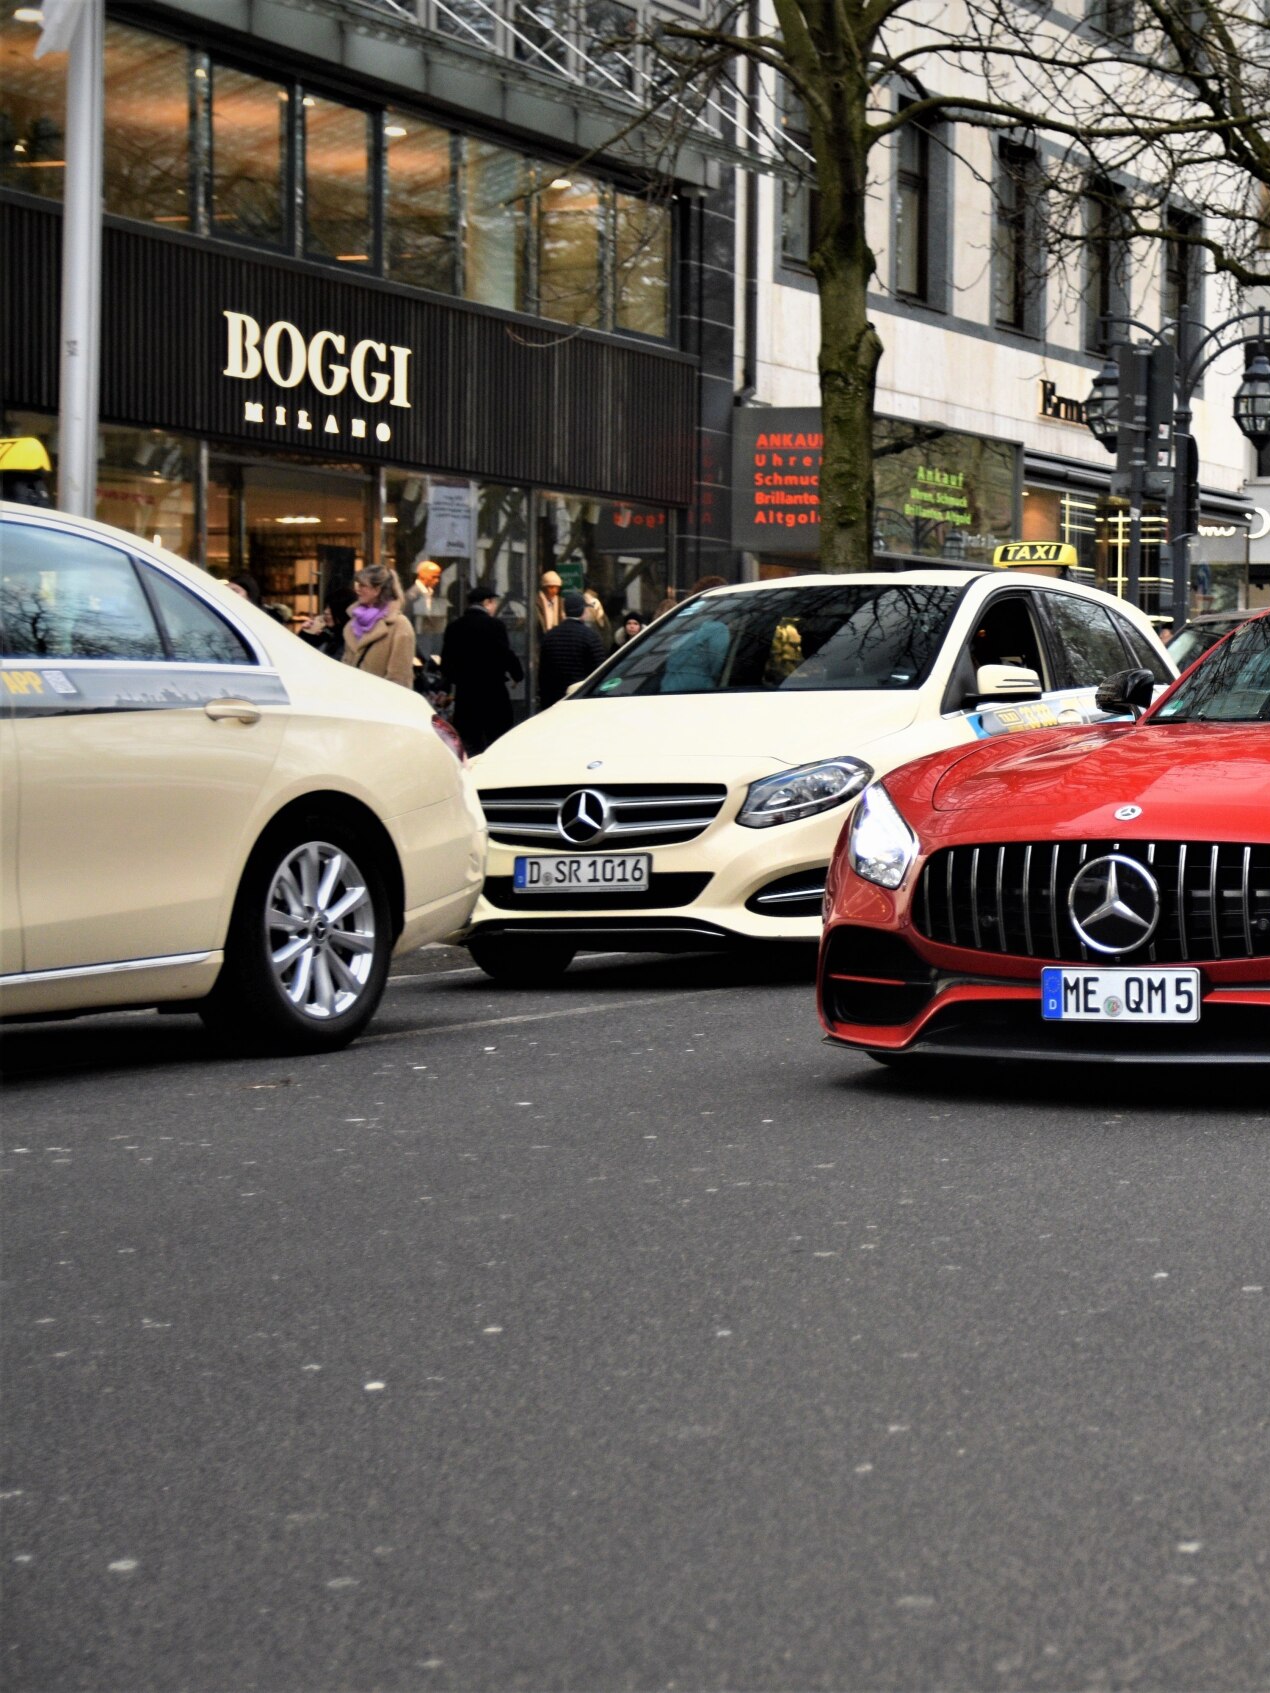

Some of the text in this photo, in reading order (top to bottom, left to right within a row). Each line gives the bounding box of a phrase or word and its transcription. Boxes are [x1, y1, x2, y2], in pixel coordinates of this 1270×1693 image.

[223, 310, 412, 408] BOGGI
[245, 402, 392, 442] MILANO
[754, 472, 819, 486] Schmuc
[754, 491, 820, 505] Brillante
[1006, 545, 1059, 561] TAXI
[529, 859, 644, 884] D SR 1016
[1063, 977, 1194, 1013] ME QM 5
